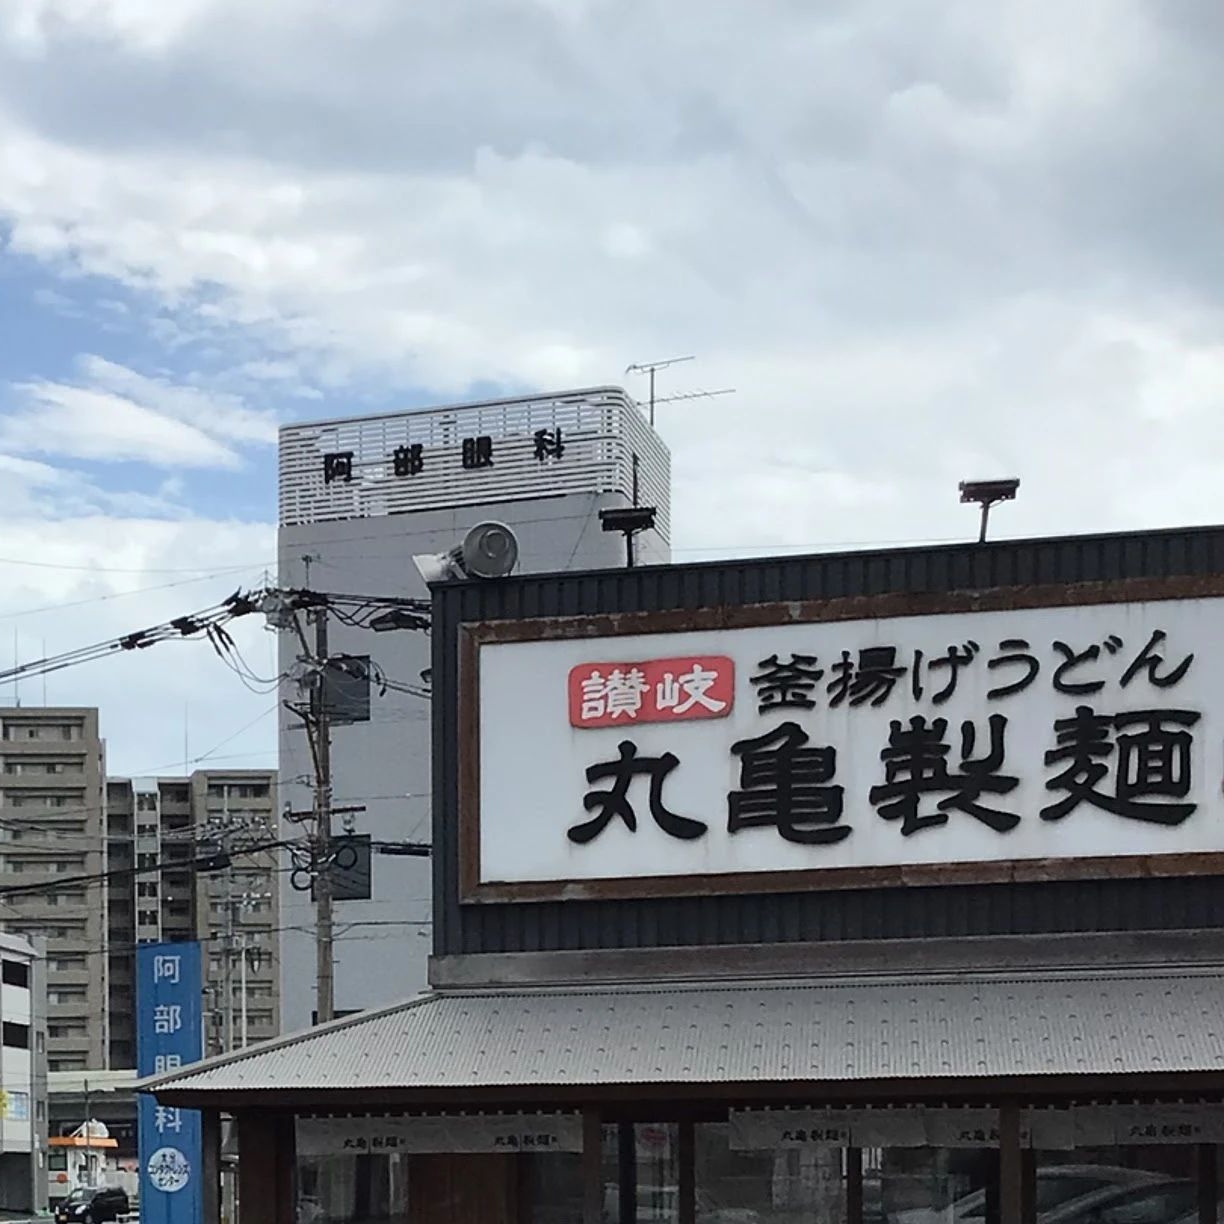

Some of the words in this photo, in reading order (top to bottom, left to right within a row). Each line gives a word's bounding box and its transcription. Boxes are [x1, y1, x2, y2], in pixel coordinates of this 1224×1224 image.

[324, 427, 565, 484] 阿部眼科
[580, 663, 727, 720] 讃岐
[749, 629, 1195, 715] 釜揚げうどん
[566, 705, 1202, 845] 丸亀製麺
